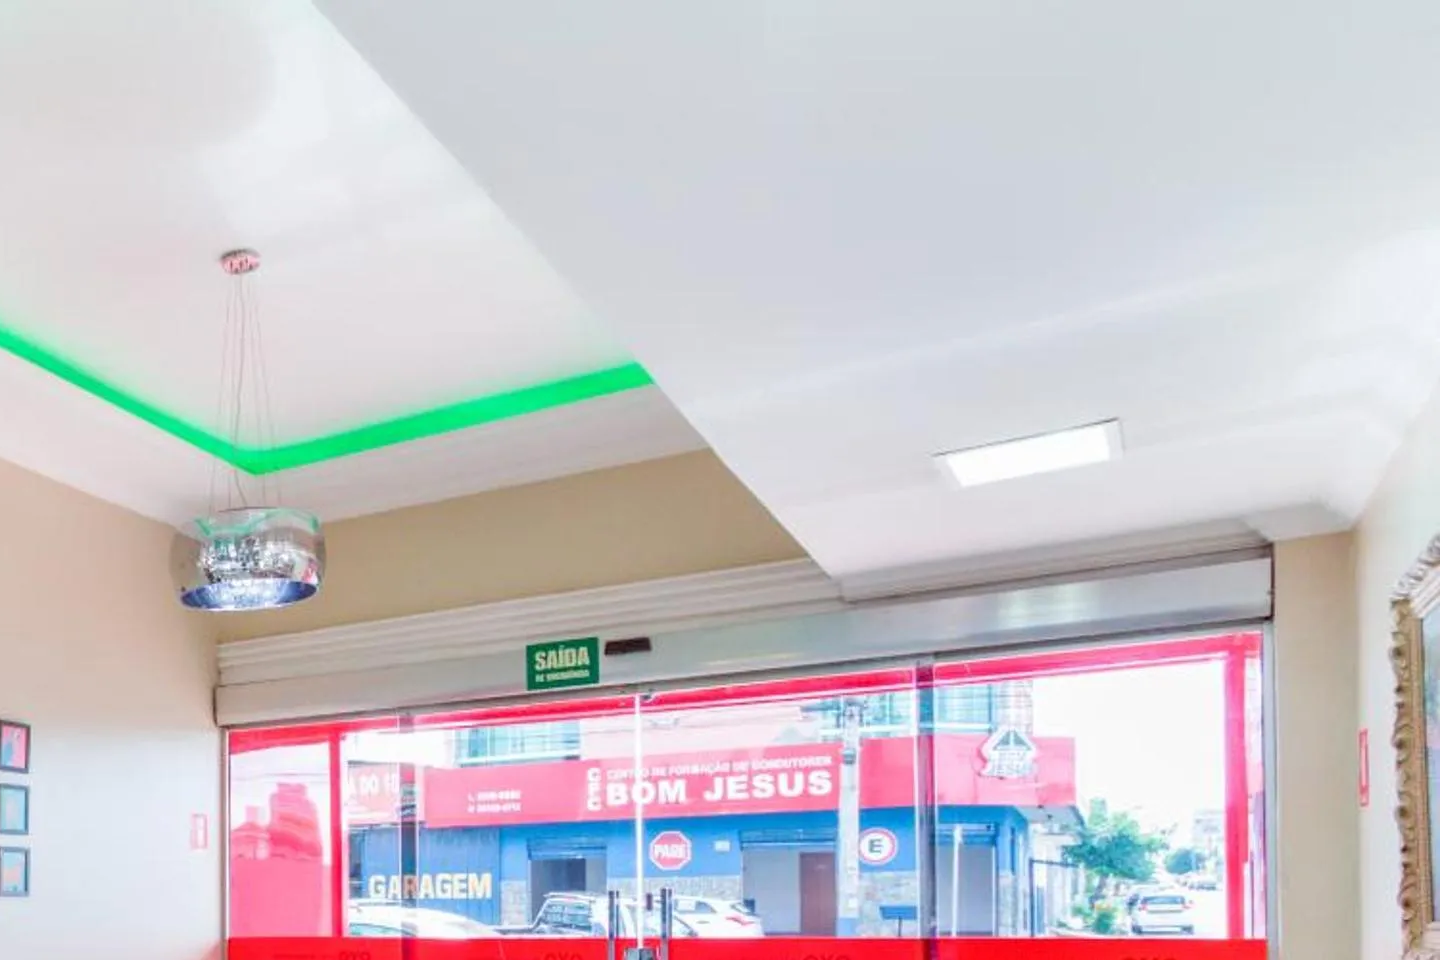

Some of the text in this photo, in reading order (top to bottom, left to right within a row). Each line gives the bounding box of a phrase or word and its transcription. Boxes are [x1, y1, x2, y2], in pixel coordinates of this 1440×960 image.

[535, 645, 590, 671] SAÍDA
[606, 769, 833, 807] BOM JESUS
[867, 838, 884, 854] E
[368, 872, 492, 900] GARAGEM
